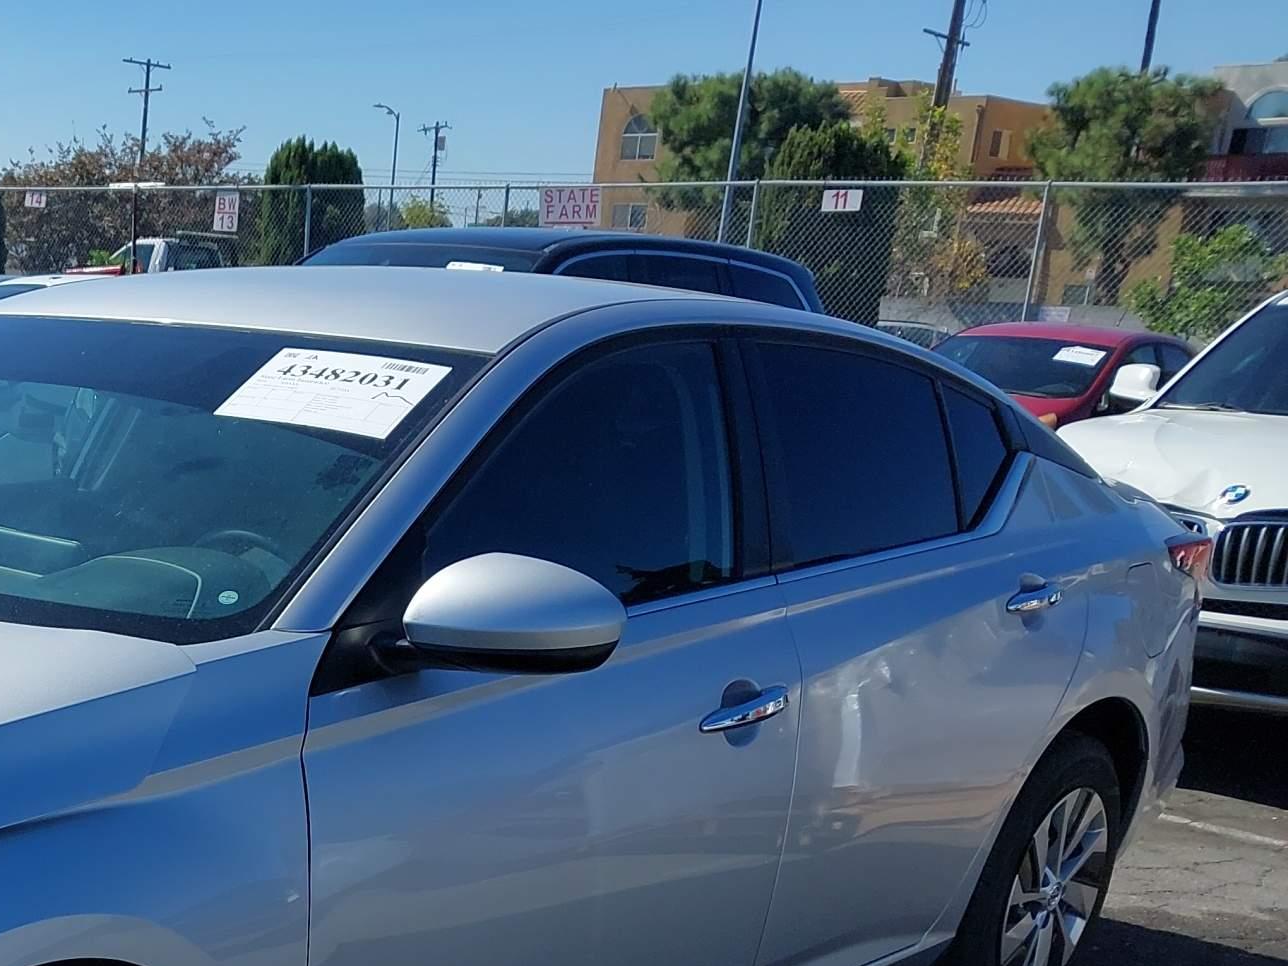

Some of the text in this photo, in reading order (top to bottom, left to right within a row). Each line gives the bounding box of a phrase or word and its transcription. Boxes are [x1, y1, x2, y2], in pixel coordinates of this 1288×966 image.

[29, 191, 42, 206] 14
[218, 196, 238, 211] BW
[543, 188, 600, 204] STATE
[831, 190, 849, 209] 11
[545, 204, 598, 220] FARM
[218, 214, 234, 230] 13
[275, 363, 411, 391] 43482031
